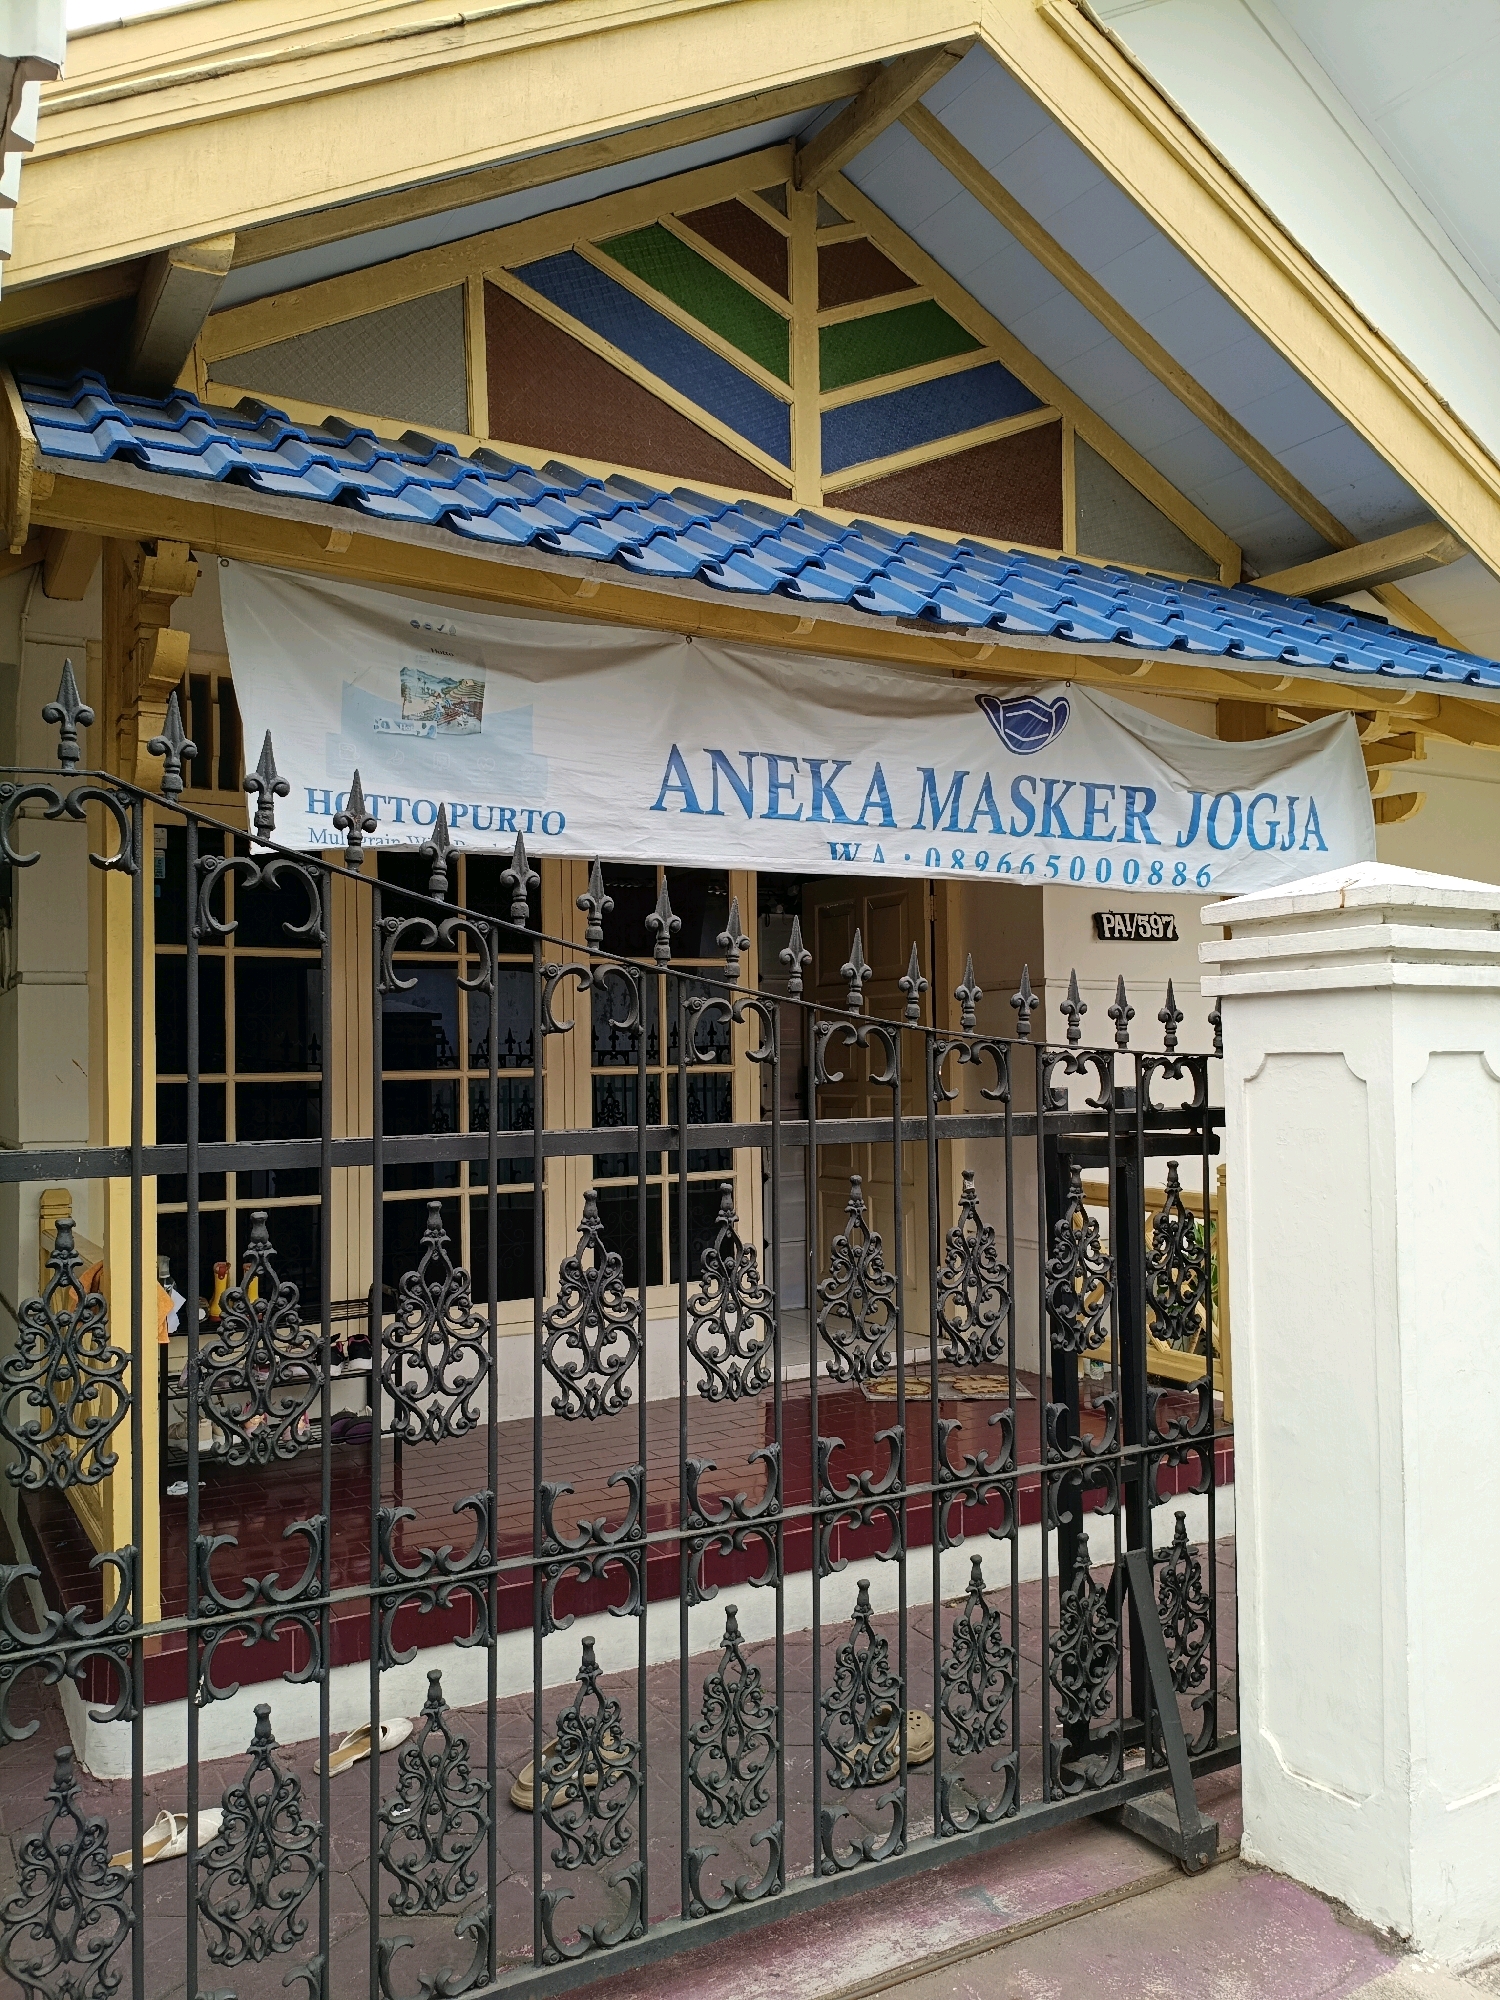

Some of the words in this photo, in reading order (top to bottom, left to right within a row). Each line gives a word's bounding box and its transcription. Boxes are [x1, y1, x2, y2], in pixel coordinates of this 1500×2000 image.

[447, 802, 566, 836] PURTO
[649, 743, 897, 829] ANEKA
[911, 766, 1162, 845] MASKER
[1176, 790, 1329, 852] JOGJA
